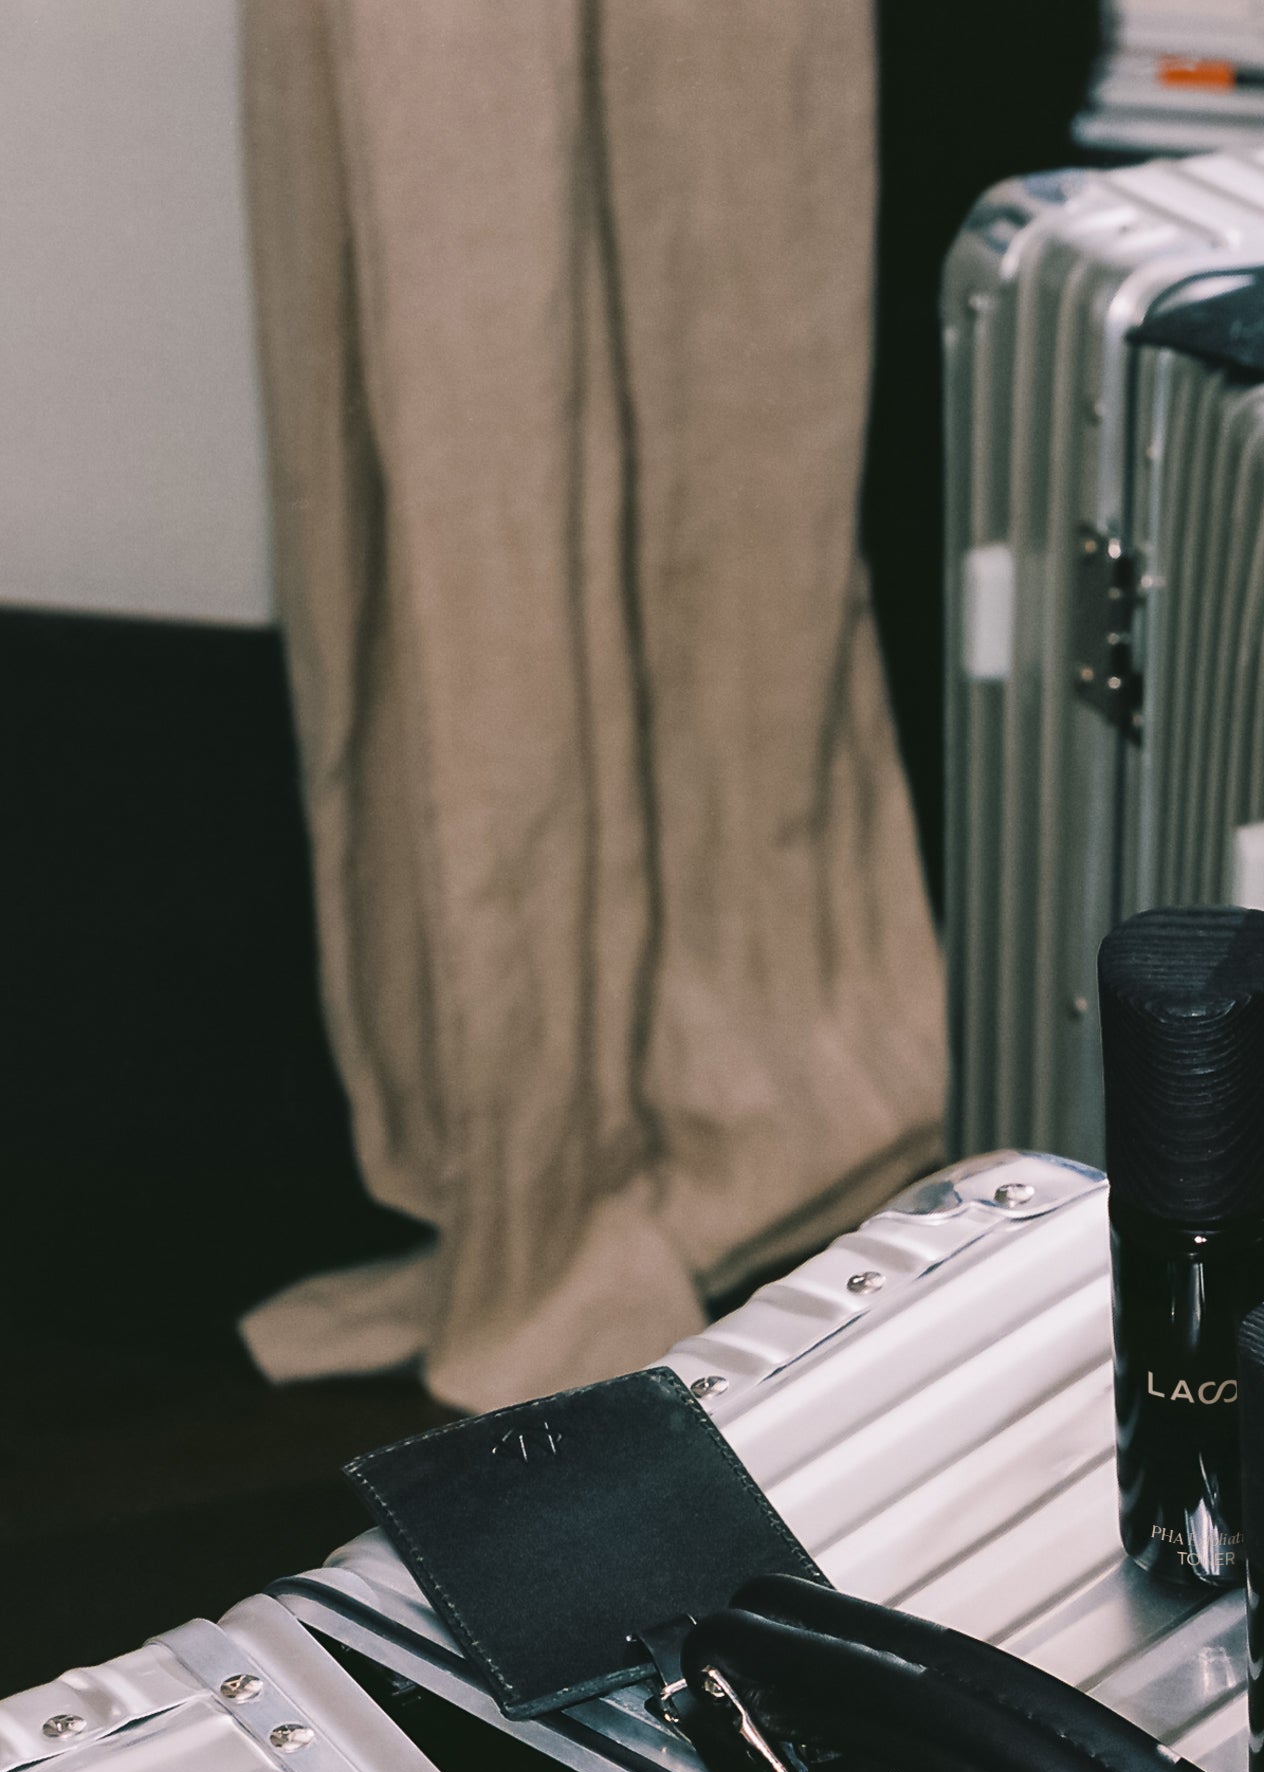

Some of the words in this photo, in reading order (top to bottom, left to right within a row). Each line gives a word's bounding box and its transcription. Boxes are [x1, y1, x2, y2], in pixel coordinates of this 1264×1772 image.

[1147, 1370, 1238, 1405] LACO
[1150, 1524, 1185, 1546] PHA
[1176, 1551, 1236, 1567] TOER
